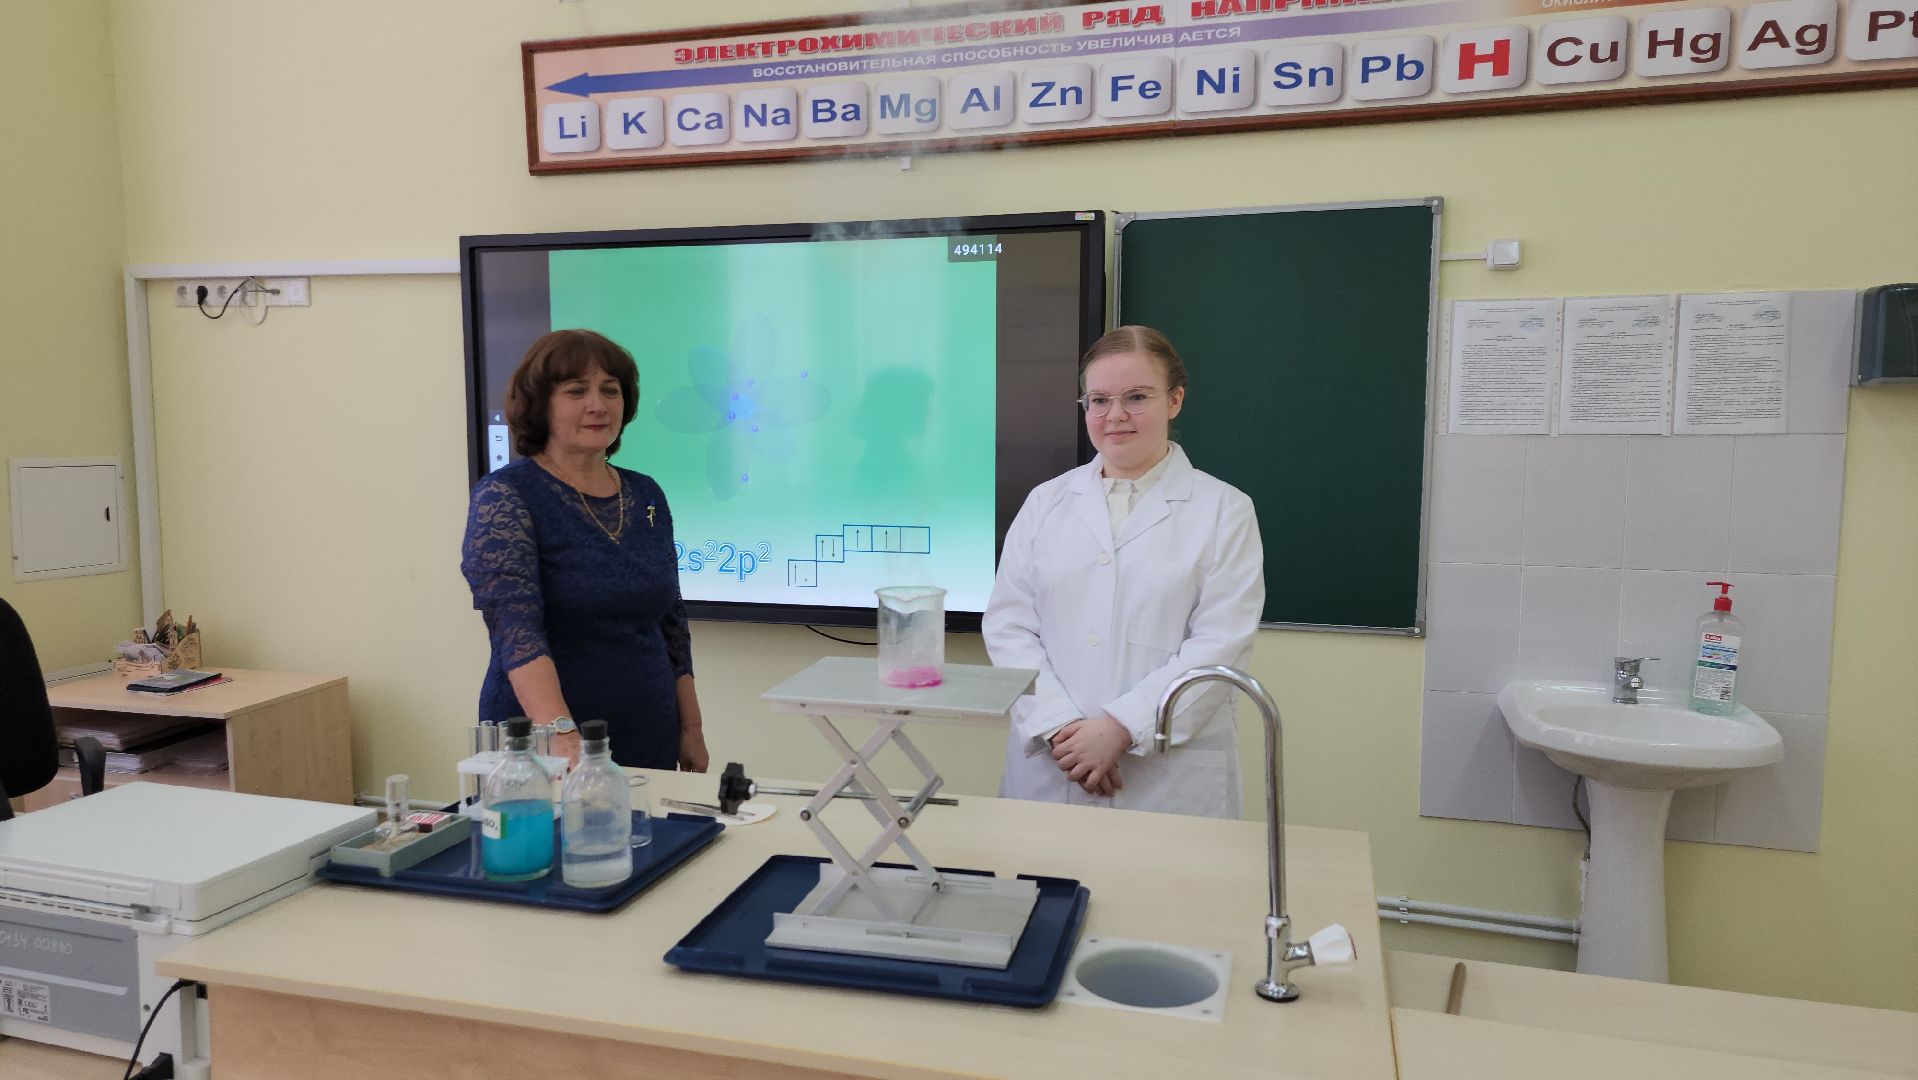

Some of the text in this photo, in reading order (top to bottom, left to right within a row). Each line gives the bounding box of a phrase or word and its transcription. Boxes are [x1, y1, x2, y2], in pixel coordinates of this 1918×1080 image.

[674, 12, 1064, 64] ЭЛЕКТРОХИМИЧЕСКИЙ
[1082, 5, 1164, 28] РЯД
[559, 117, 587, 139] Li
[623, 112, 647, 135] K
[677, 108, 723, 131] Ca
[744, 104, 790, 127] Na
[812, 99, 861, 123] Ba
[880, 94, 937, 123] Mg
[960, 86, 1000, 113] Al
[1030, 82, 1083, 107] Zn
[1110, 75, 1162, 101] Fe
[1196, 67, 1240, 95] Ni
[1273, 62, 1334, 89] Sn
[1361, 54, 1424, 83] Pb
[1458, 39, 1510, 80] H
[1547, 37, 1619, 66] Cu
[1647, 28, 1722, 63] Hg
[1747, 19, 1829, 55] Ag
[753, 55, 936, 78] ВОССТАНОВИТЕЛЬНАЯ
[942, 44, 1071, 63] СПОСОБНОСТЬ
[953, 243, 1002, 256] 494114
